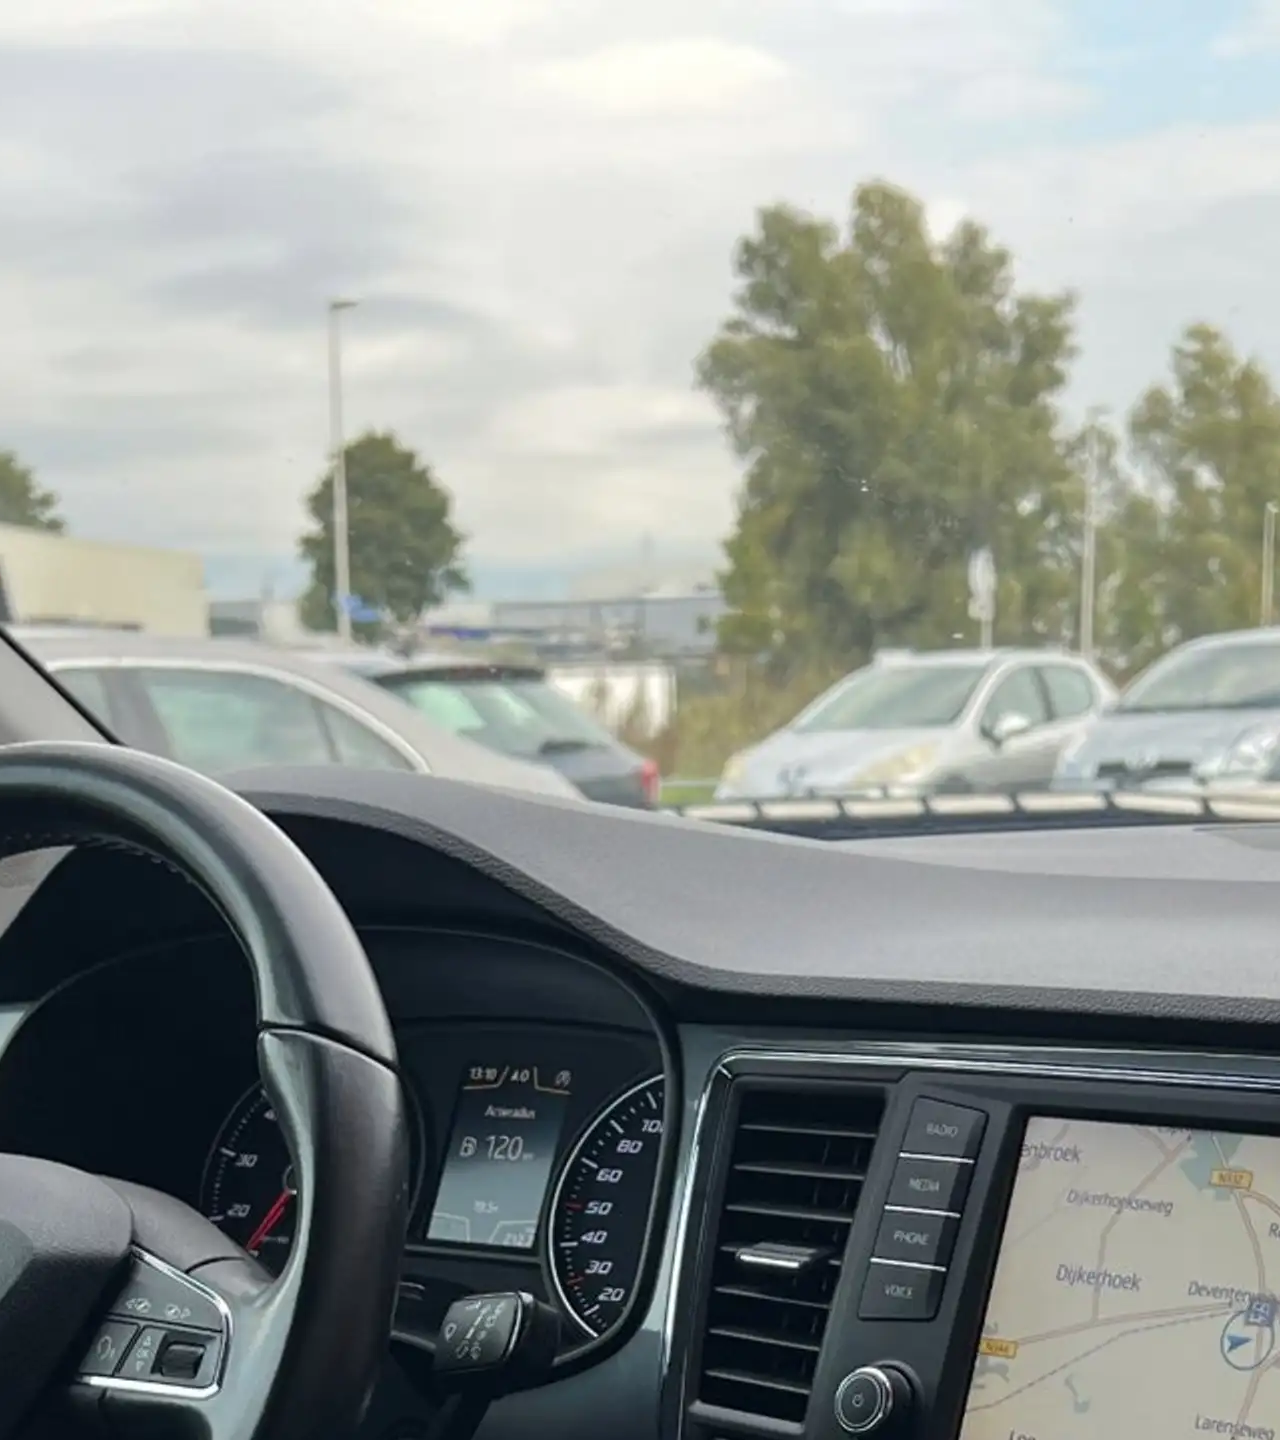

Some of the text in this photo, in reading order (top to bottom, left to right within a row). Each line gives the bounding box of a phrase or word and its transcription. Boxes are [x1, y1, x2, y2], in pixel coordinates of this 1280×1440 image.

[926, 1123, 959, 1138] RADIO
[486, 1135, 523, 1161] 120
[616, 1139, 643, 1154] 80
[596, 1169, 623, 1183] 60
[908, 1177, 940, 1192] MEDIA
[227, 1204, 251, 1217] 20
[585, 1202, 613, 1215] 50
[581, 1230, 607, 1243] 40
[893, 1230, 930, 1245] PHONE
[585, 1260, 613, 1274] 30
[1056, 1264, 1141, 1291] Dijkerhoek
[598, 1288, 625, 1302] 20
[884, 1284, 913, 1298] VOICE
